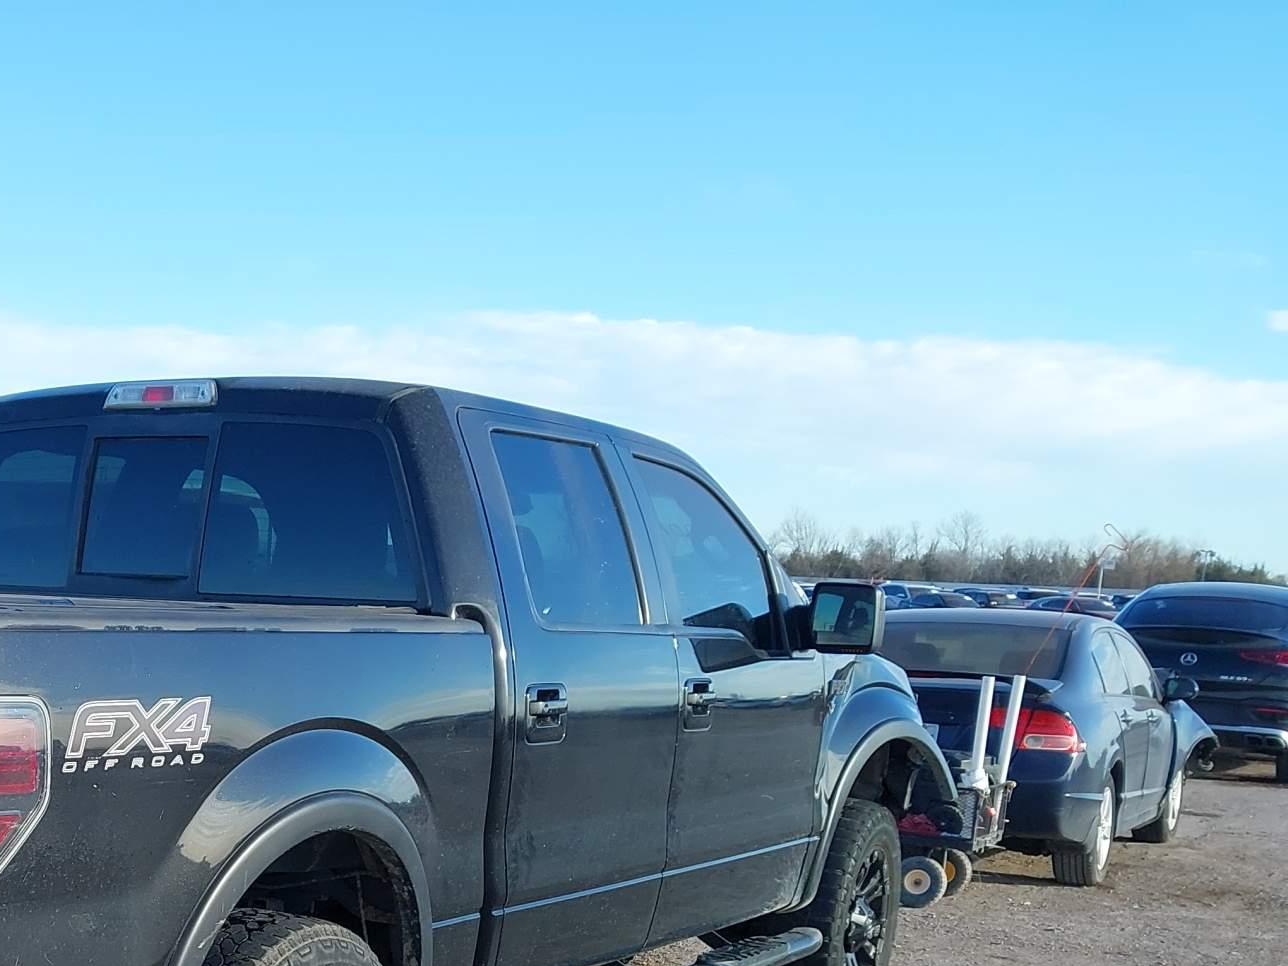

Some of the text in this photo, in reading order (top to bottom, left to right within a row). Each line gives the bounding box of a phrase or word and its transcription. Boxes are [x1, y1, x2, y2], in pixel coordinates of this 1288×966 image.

[65, 696, 212, 759] FX4
[62, 753, 205, 774] OFF ROAD
